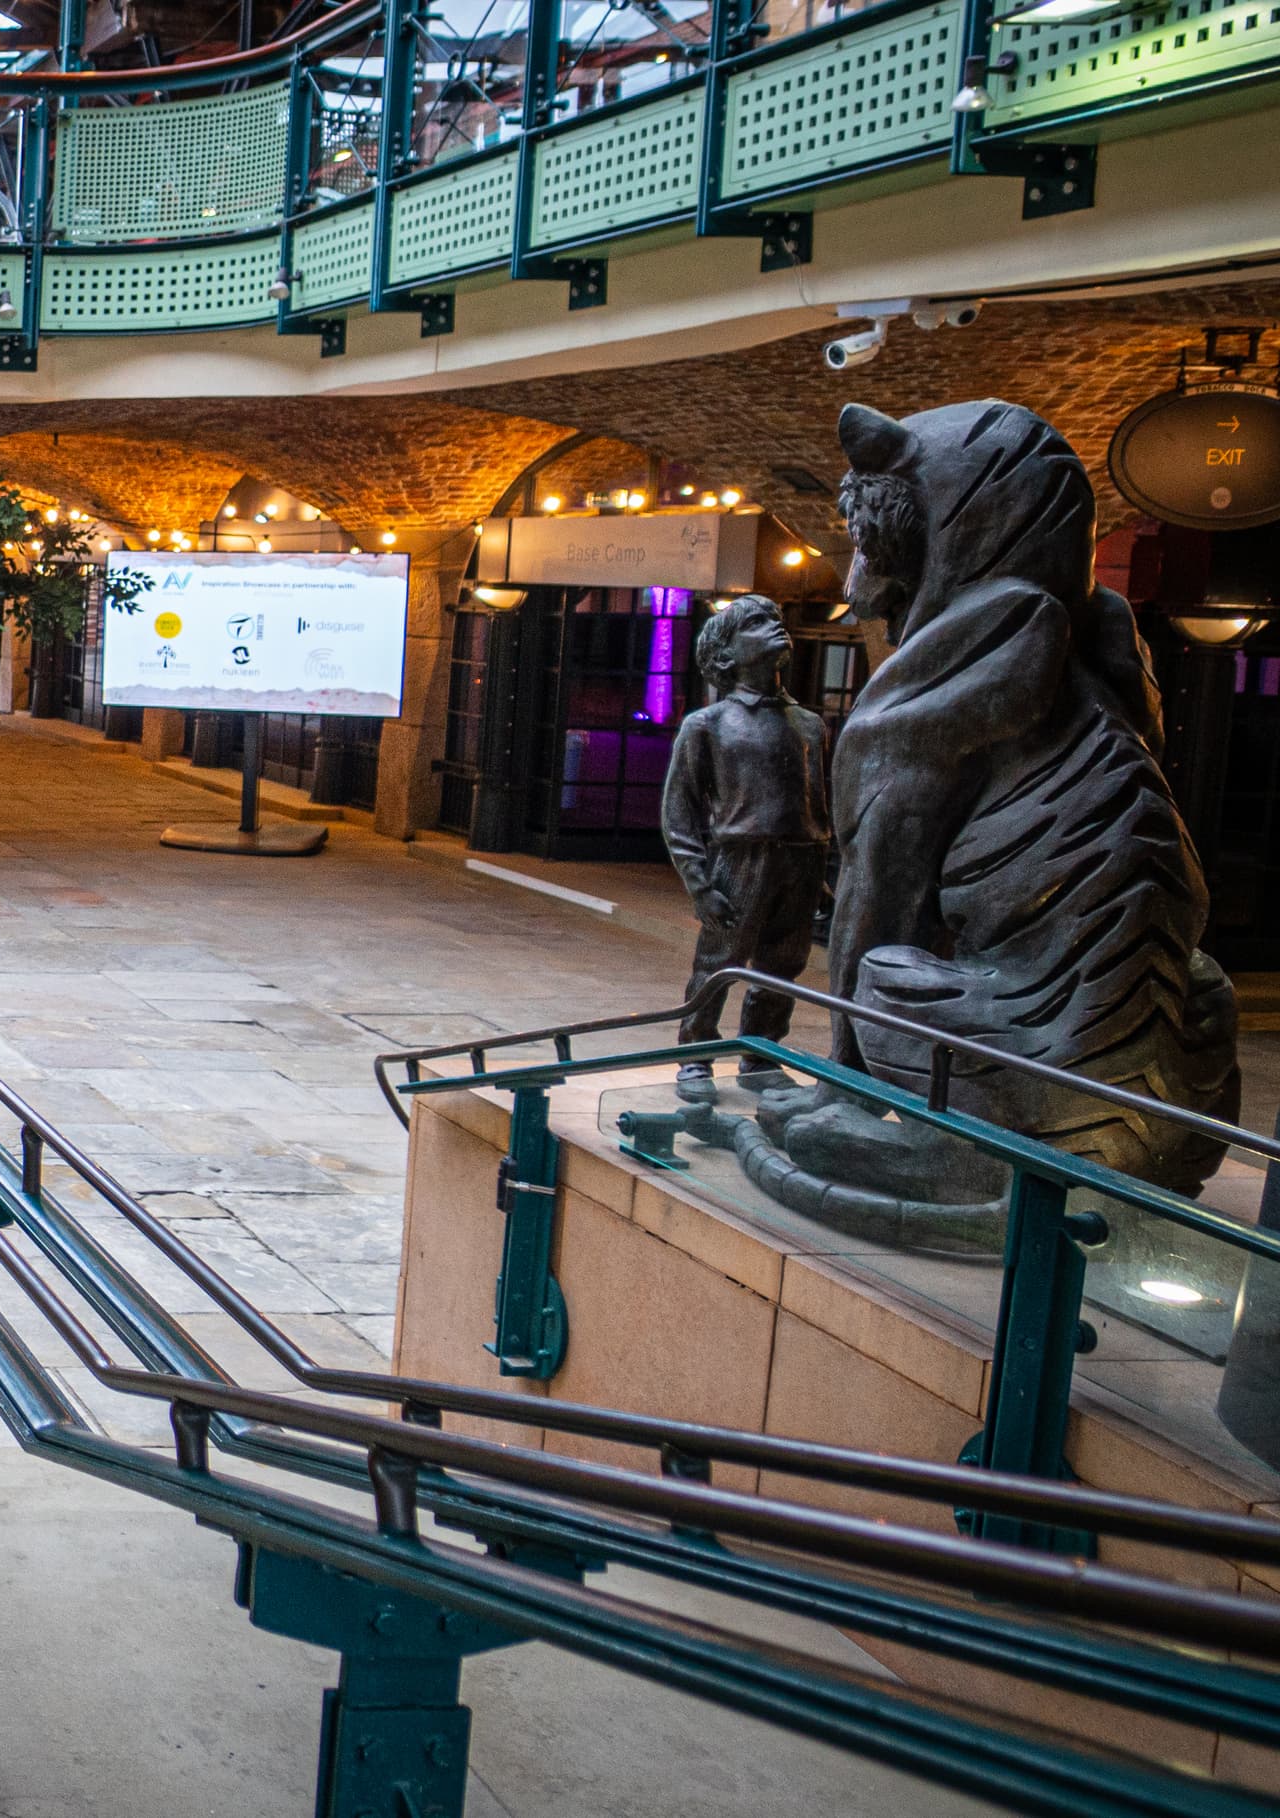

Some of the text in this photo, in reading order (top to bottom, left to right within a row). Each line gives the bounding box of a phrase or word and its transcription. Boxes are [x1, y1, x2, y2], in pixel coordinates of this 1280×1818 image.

[1206, 448, 1246, 465] EXIT
[567, 543, 646, 565] Base Camp
[292, 582, 336, 590] partnership
[316, 621, 365, 634] disguise
